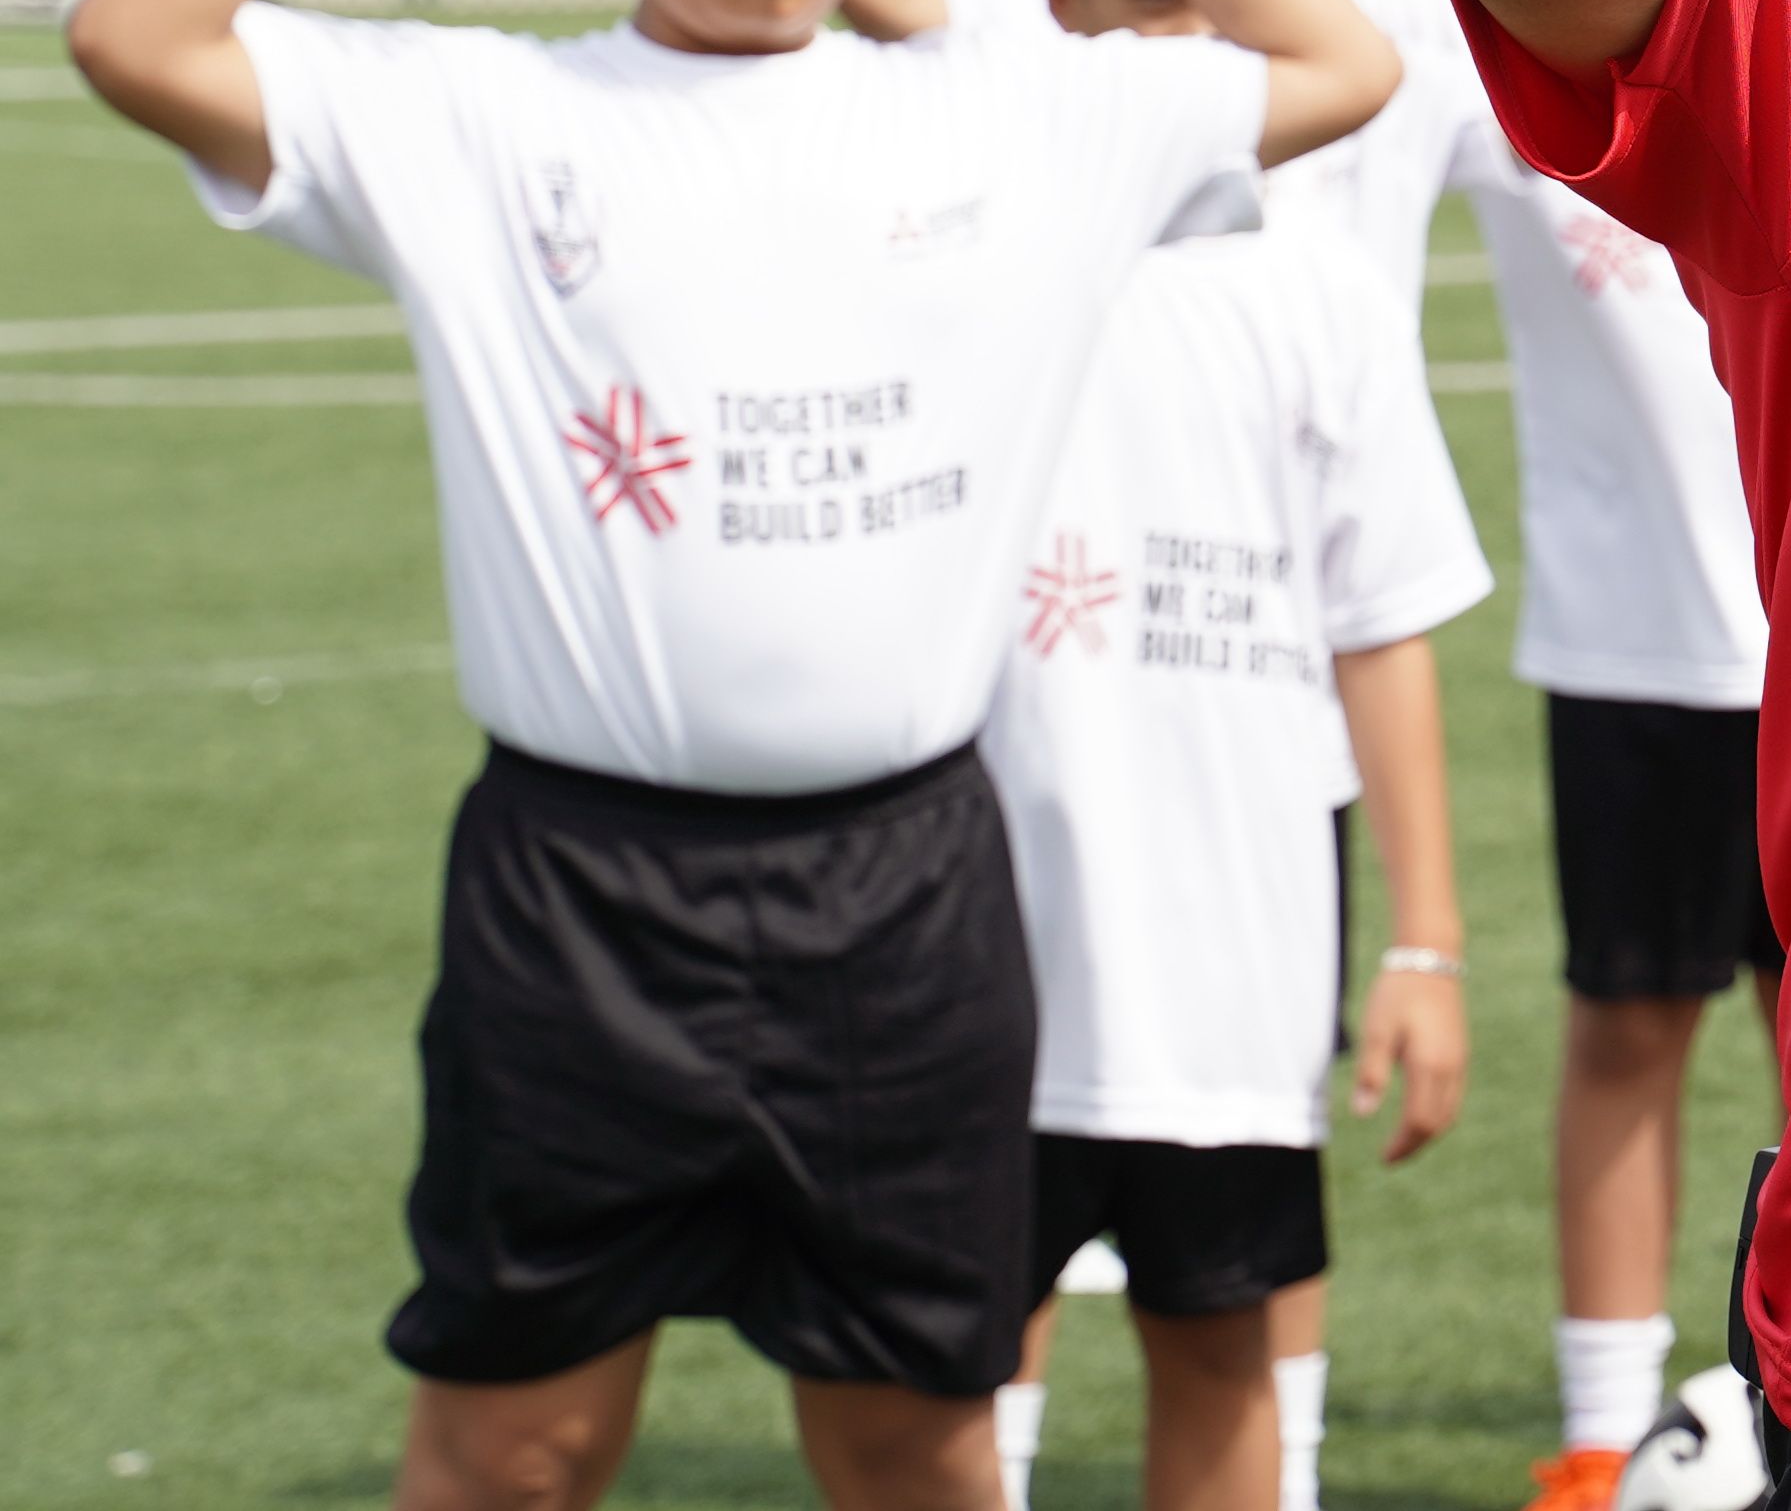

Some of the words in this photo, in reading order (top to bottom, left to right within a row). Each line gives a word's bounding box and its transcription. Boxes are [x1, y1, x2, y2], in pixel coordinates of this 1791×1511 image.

[717, 382, 910, 434] TOGETHER
[718, 448, 768, 487] WE
[792, 446, 868, 487] CAN
[719, 499, 843, 545] BUILD
[860, 465, 967, 535] BETTER
